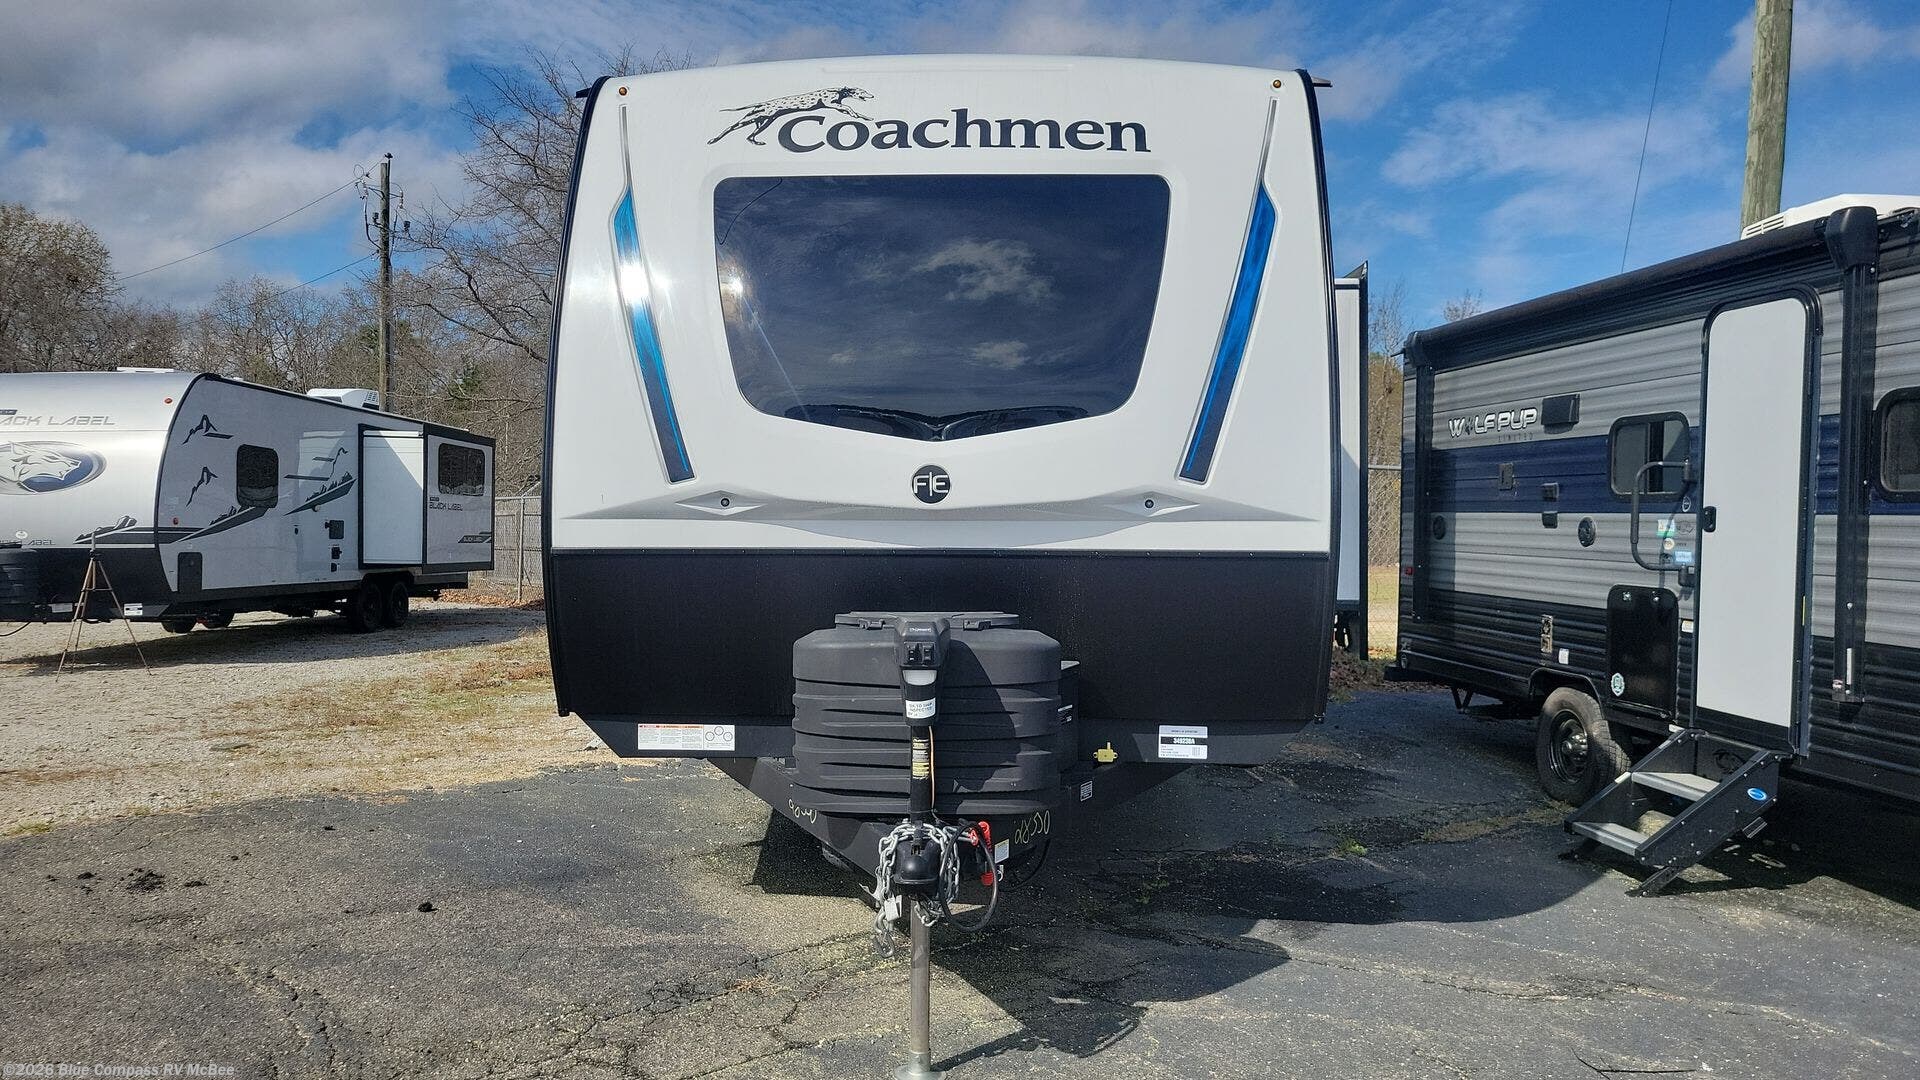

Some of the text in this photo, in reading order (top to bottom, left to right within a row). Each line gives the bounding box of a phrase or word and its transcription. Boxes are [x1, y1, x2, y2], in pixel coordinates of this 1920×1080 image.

[778, 108, 1151, 153] Coachmen
[0, 416, 116, 426] ACK LABEL
[1497, 407, 1538, 432] PUP
